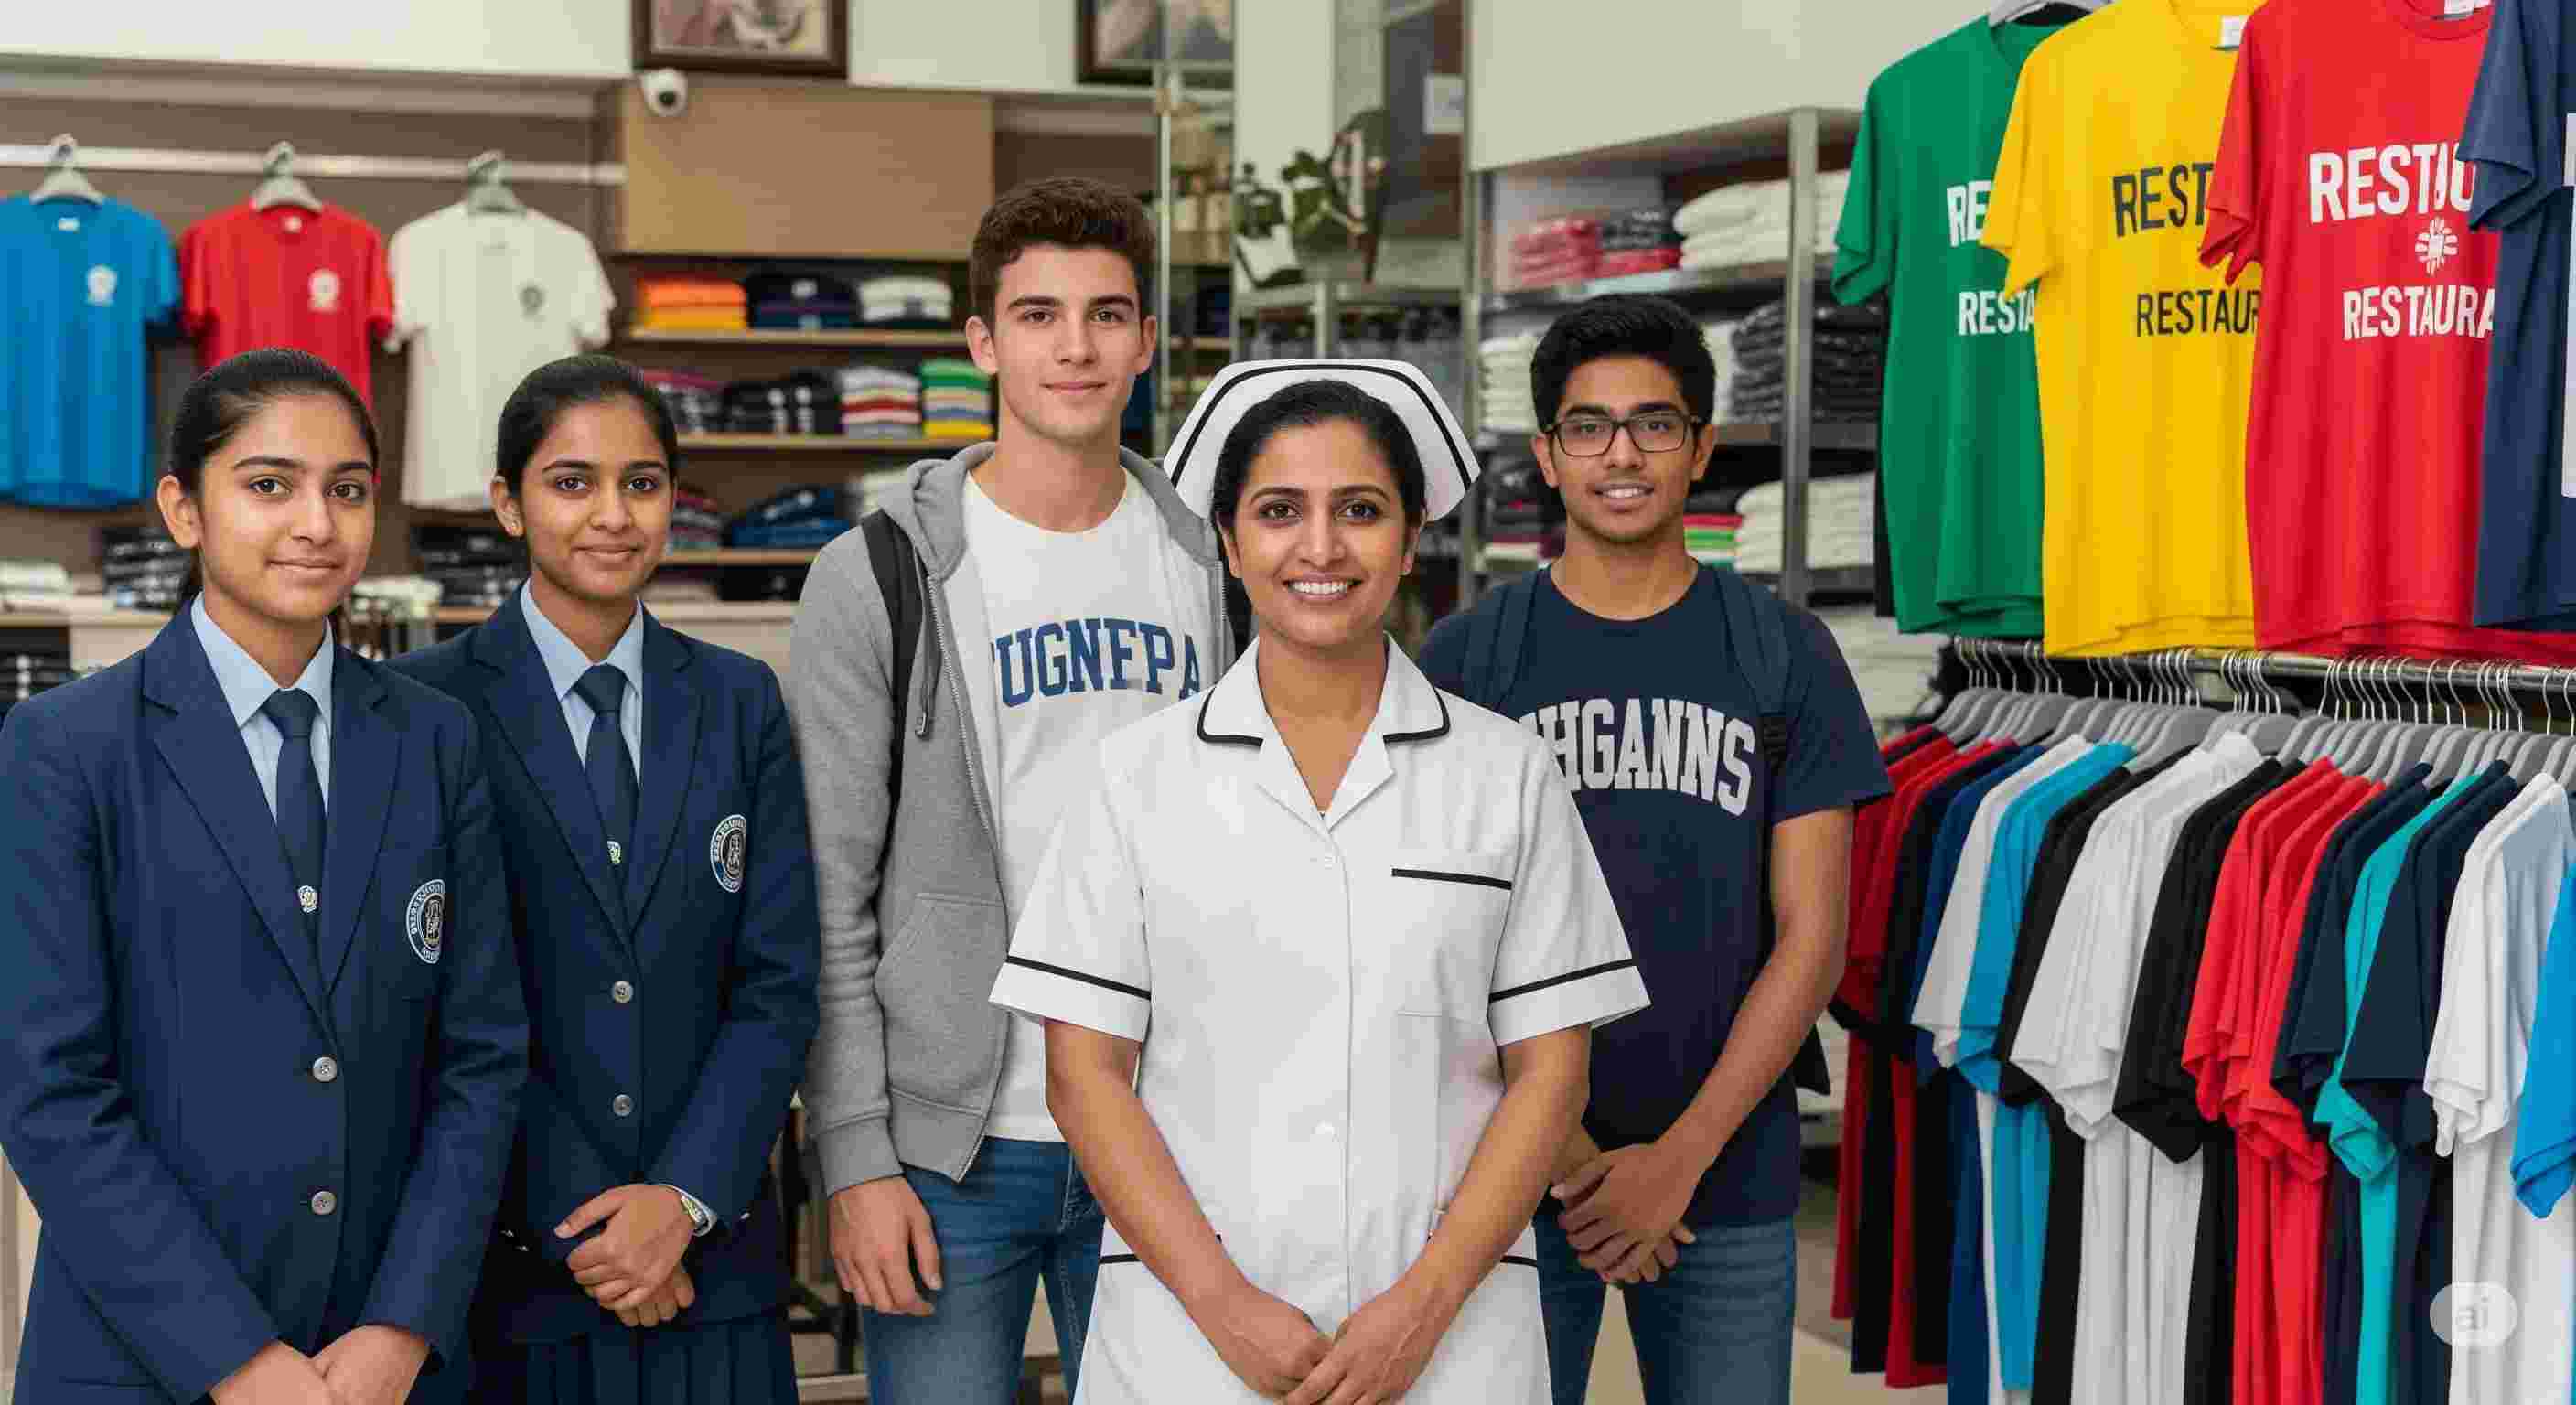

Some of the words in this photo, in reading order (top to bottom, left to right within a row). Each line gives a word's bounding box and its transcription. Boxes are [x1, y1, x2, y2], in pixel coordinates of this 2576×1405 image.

[2112, 162, 2214, 237] REST
[991, 617, 1200, 708] UGNFPA
[1520, 698, 1755, 816] HGANNS
